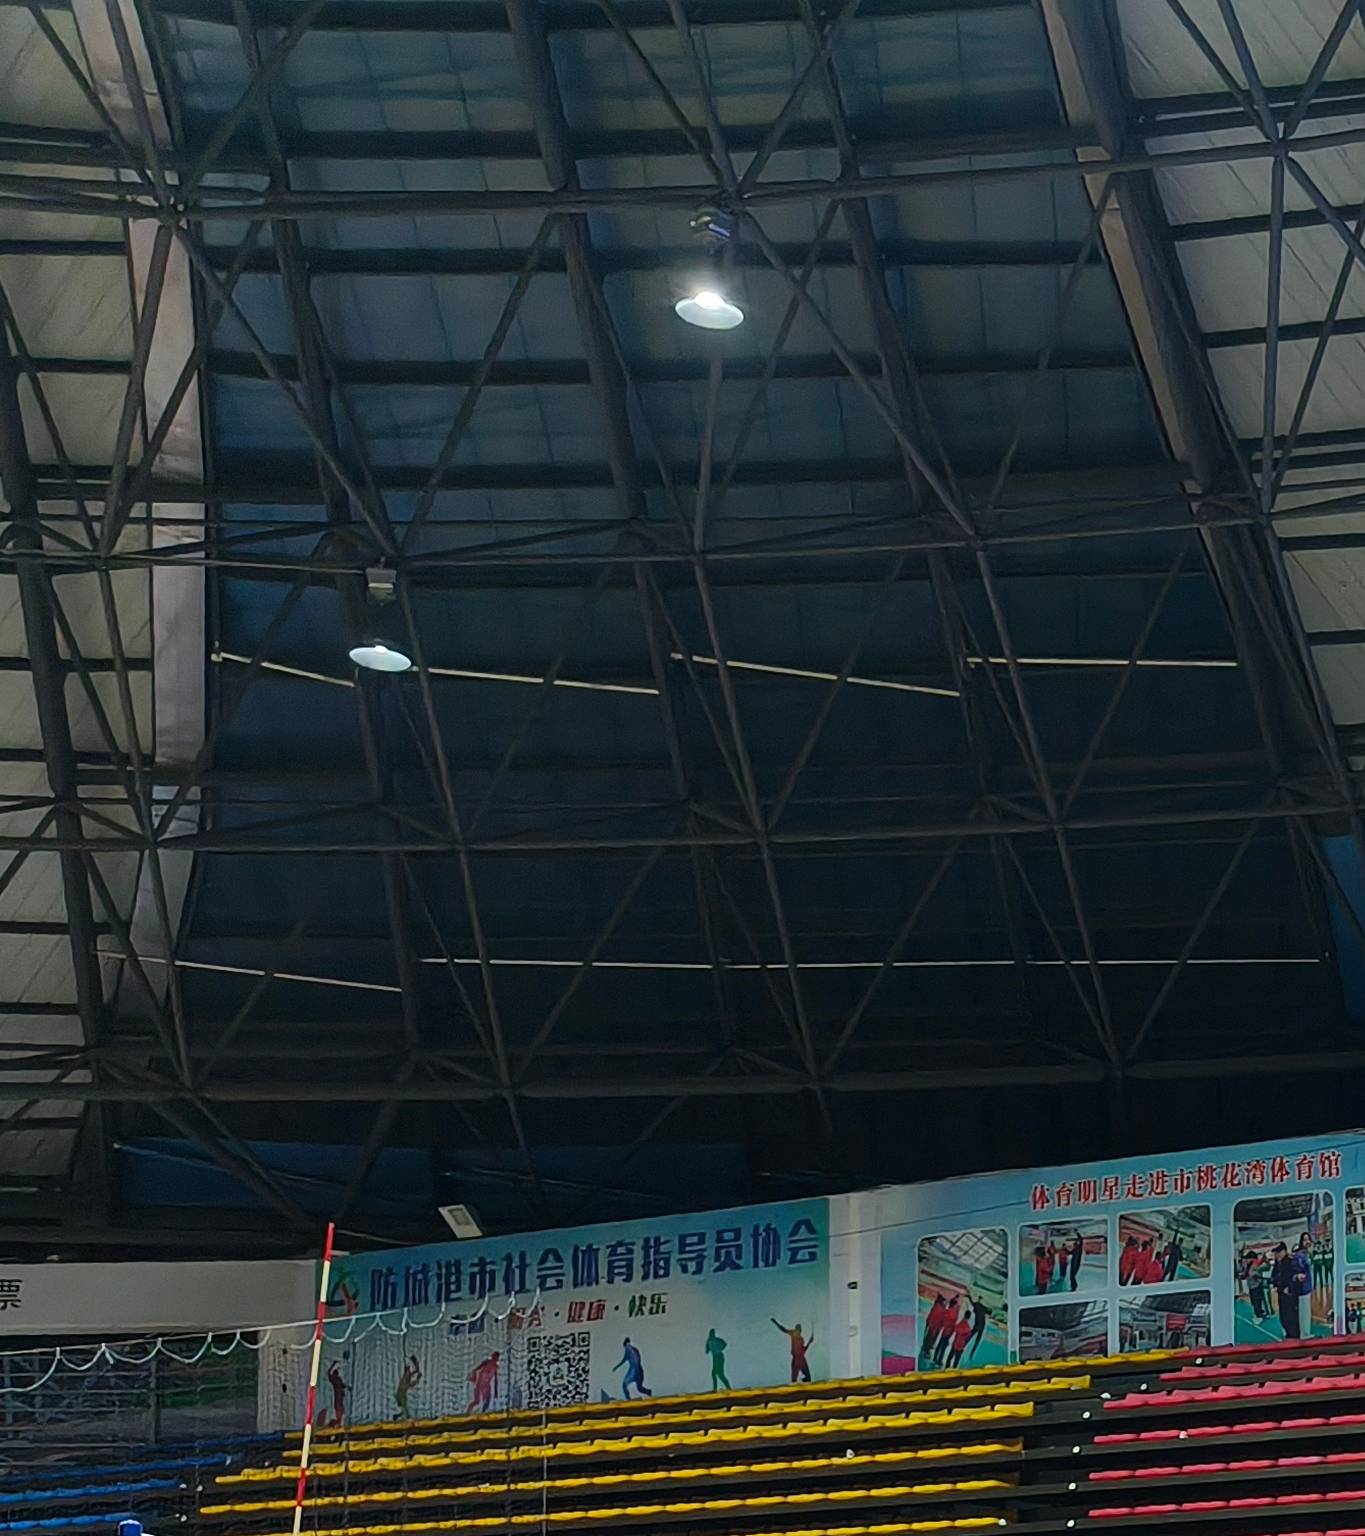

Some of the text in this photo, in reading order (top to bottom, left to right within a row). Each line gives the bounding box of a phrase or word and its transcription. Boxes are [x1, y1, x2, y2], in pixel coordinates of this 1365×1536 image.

[1031, 1150, 1343, 1211] 体育明星走进市桃花湾体育馆
[0, 1278, 23, 1309] 票
[369, 1217, 820, 1314] 防城港市社会体育指导员协会
